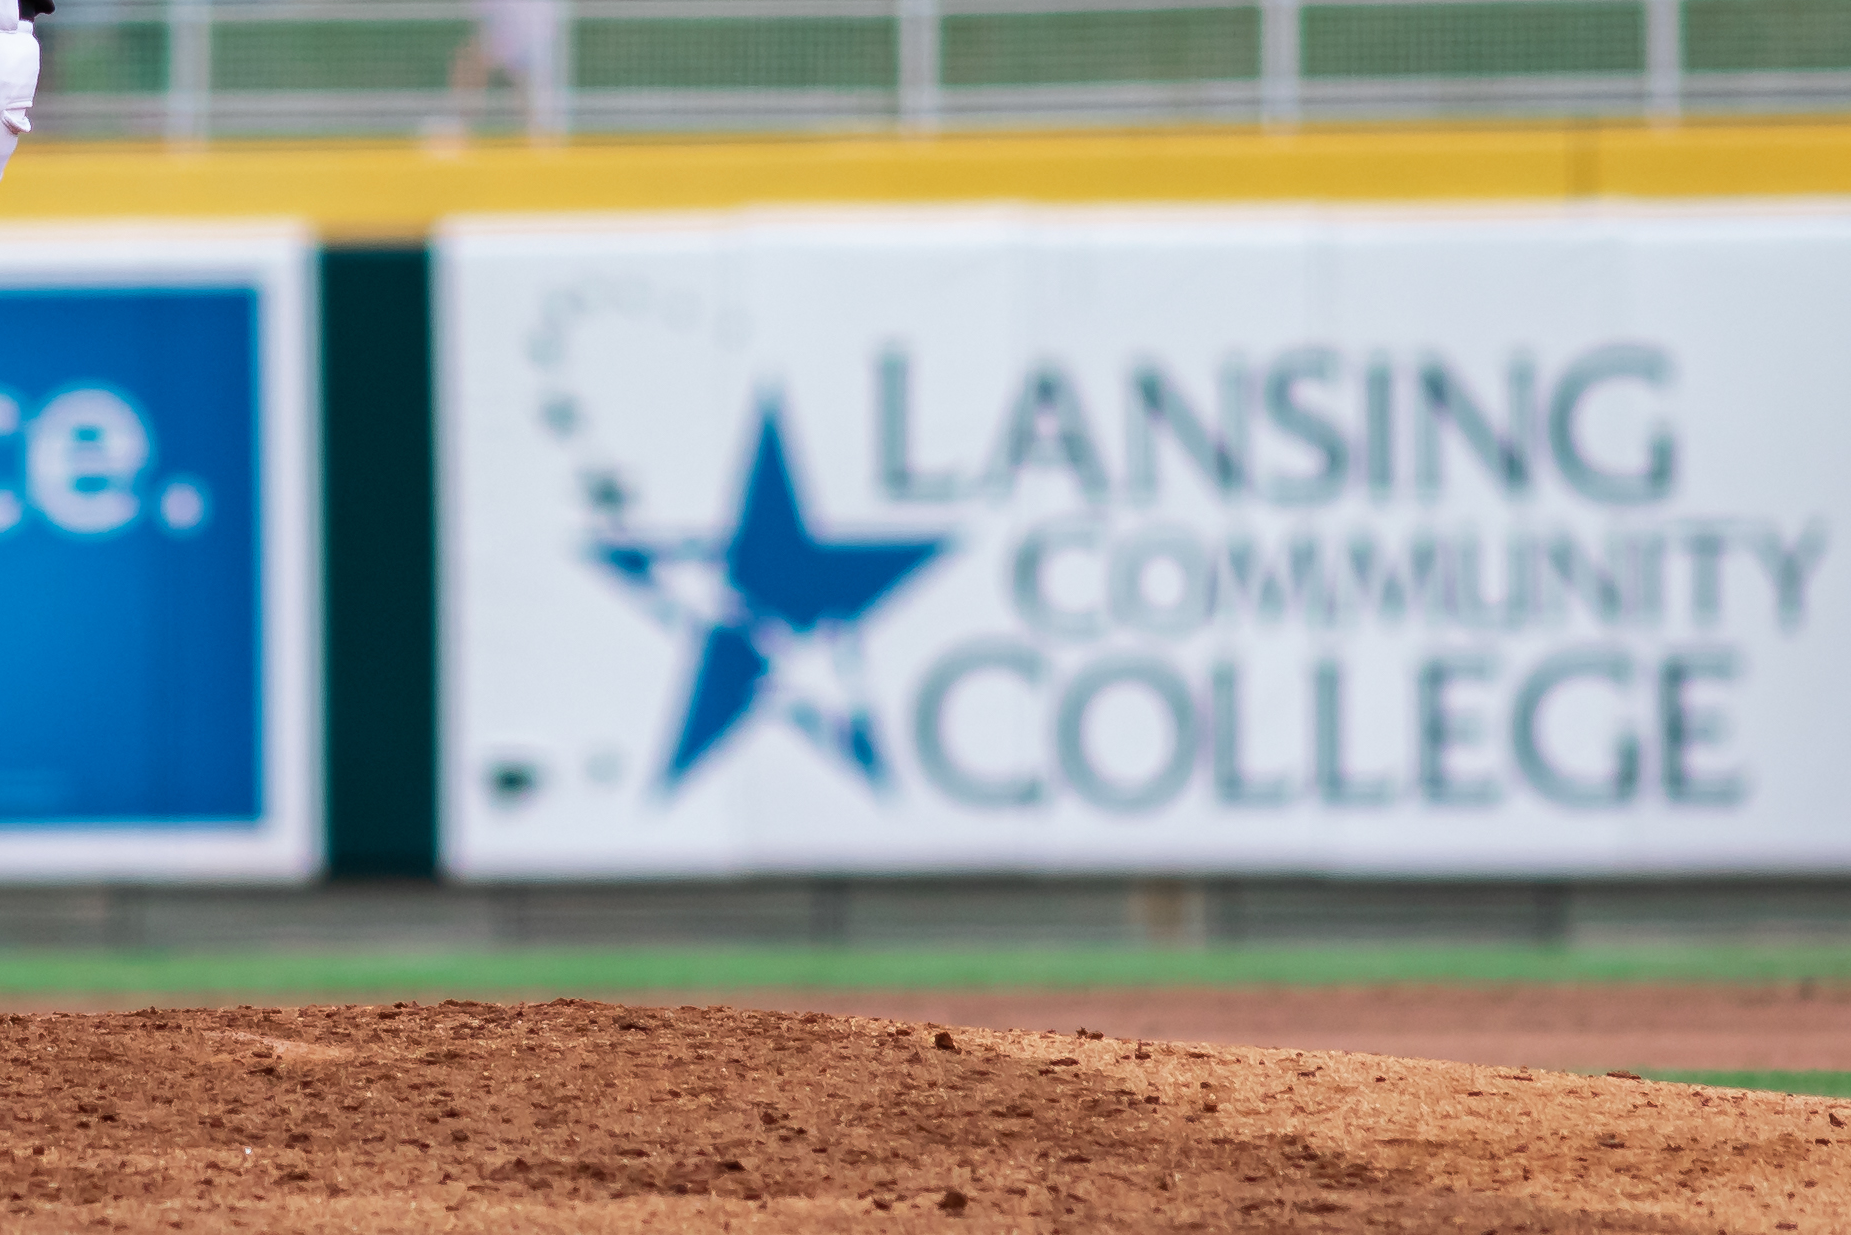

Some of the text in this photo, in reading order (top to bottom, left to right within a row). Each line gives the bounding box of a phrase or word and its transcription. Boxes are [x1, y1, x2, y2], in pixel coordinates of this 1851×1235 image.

[876, 340, 1678, 507] LANSING
[1012, 518, 1826, 639] COMMUNITY
[912, 637, 1751, 812] COLLEGE
